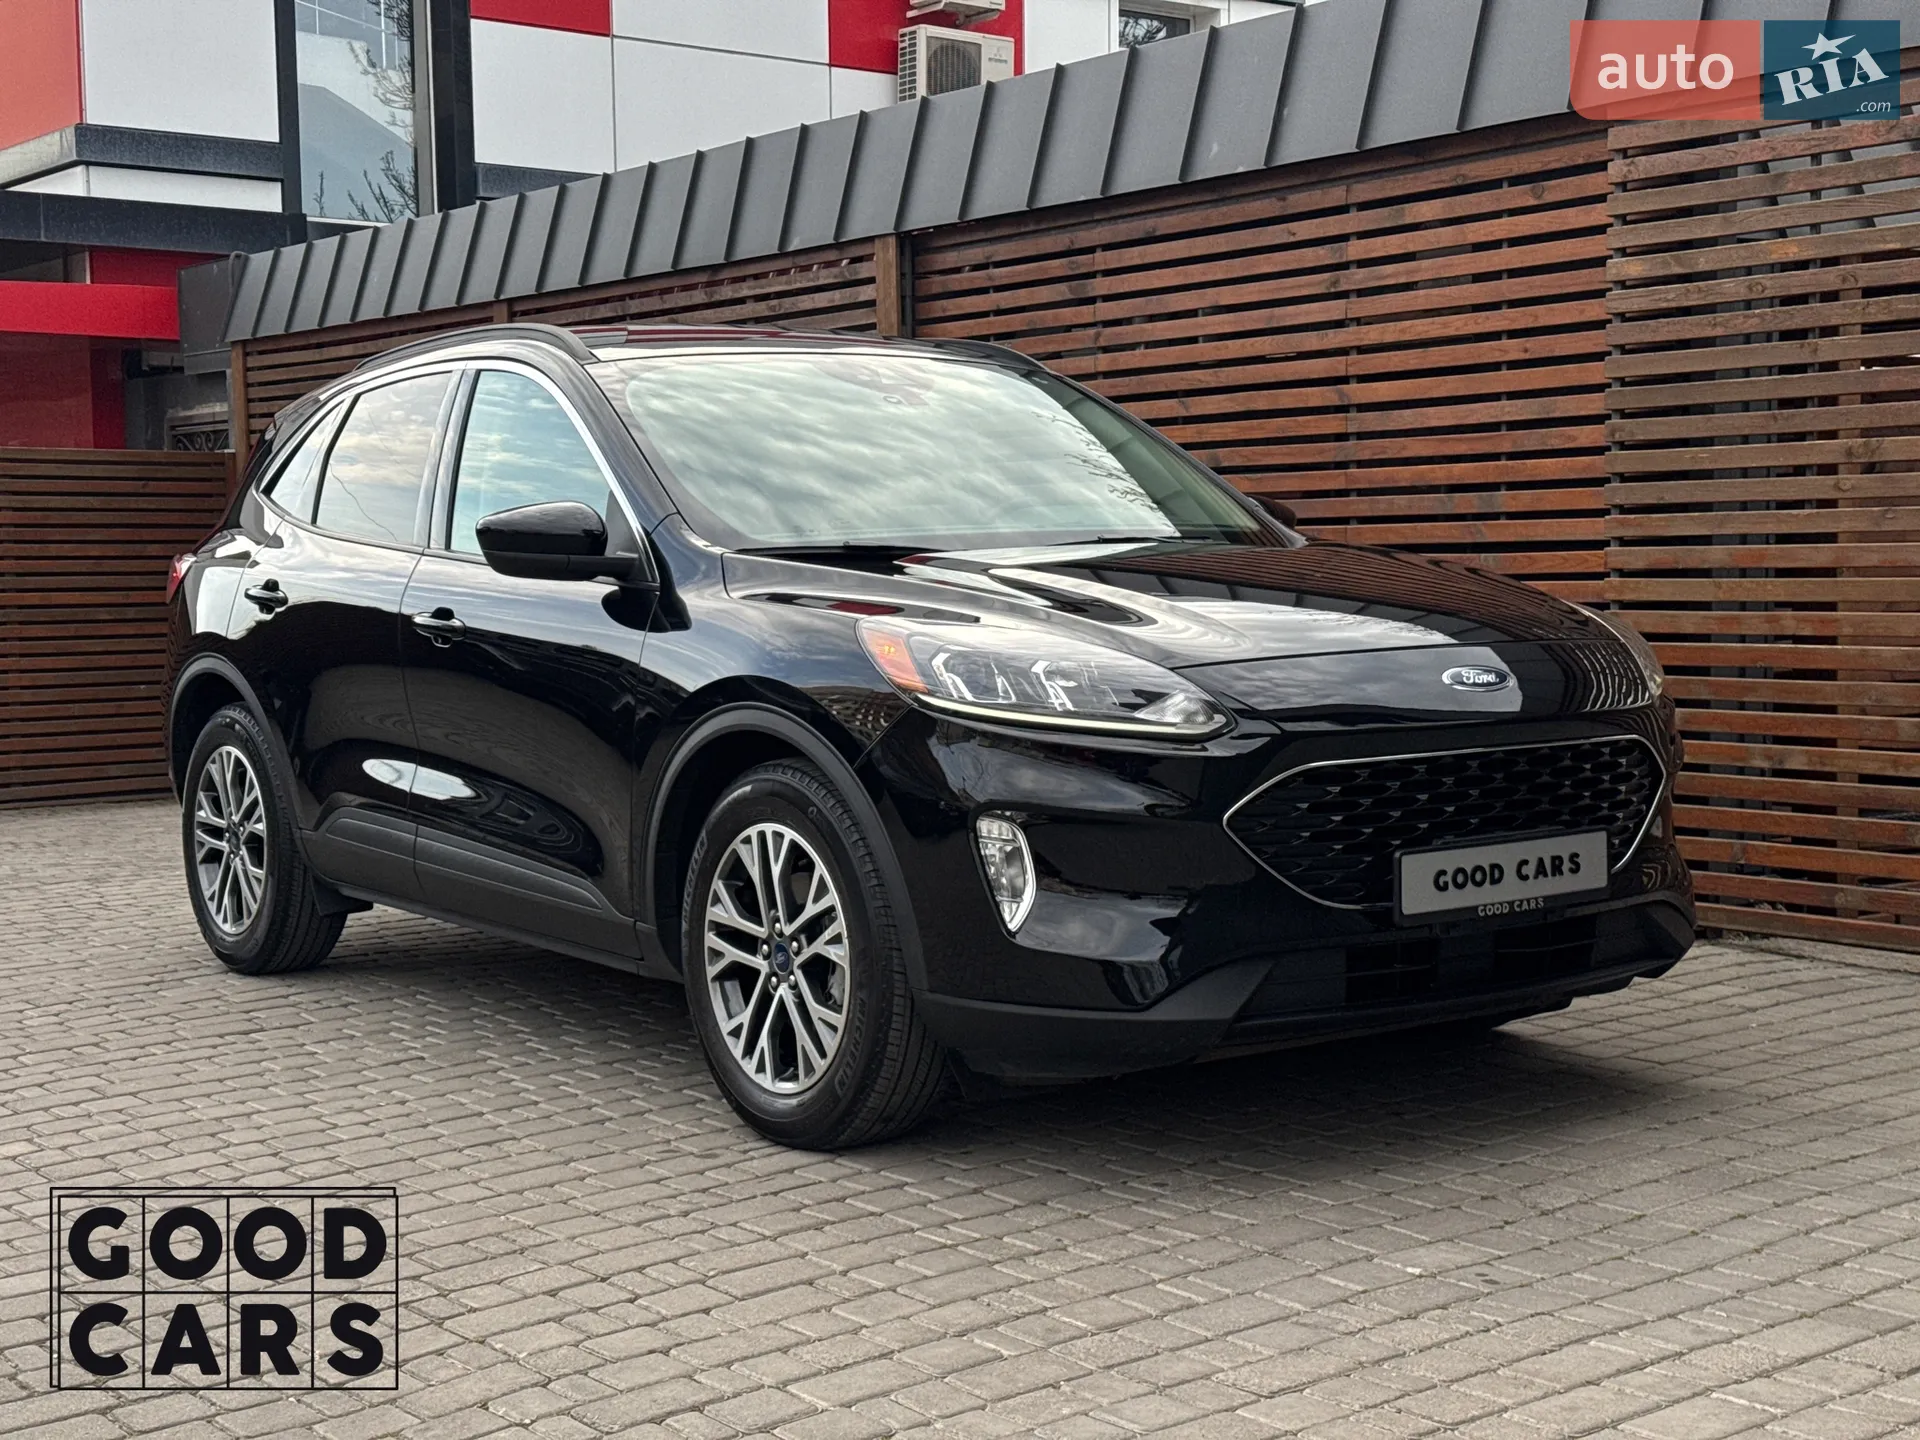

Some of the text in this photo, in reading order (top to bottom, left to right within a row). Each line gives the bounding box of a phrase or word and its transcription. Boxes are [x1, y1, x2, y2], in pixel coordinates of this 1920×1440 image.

[1460, 669, 1497, 684] Ford
[1433, 852, 1581, 892] GOOD CARS
[1477, 897, 1544, 917] GOOD CARS
